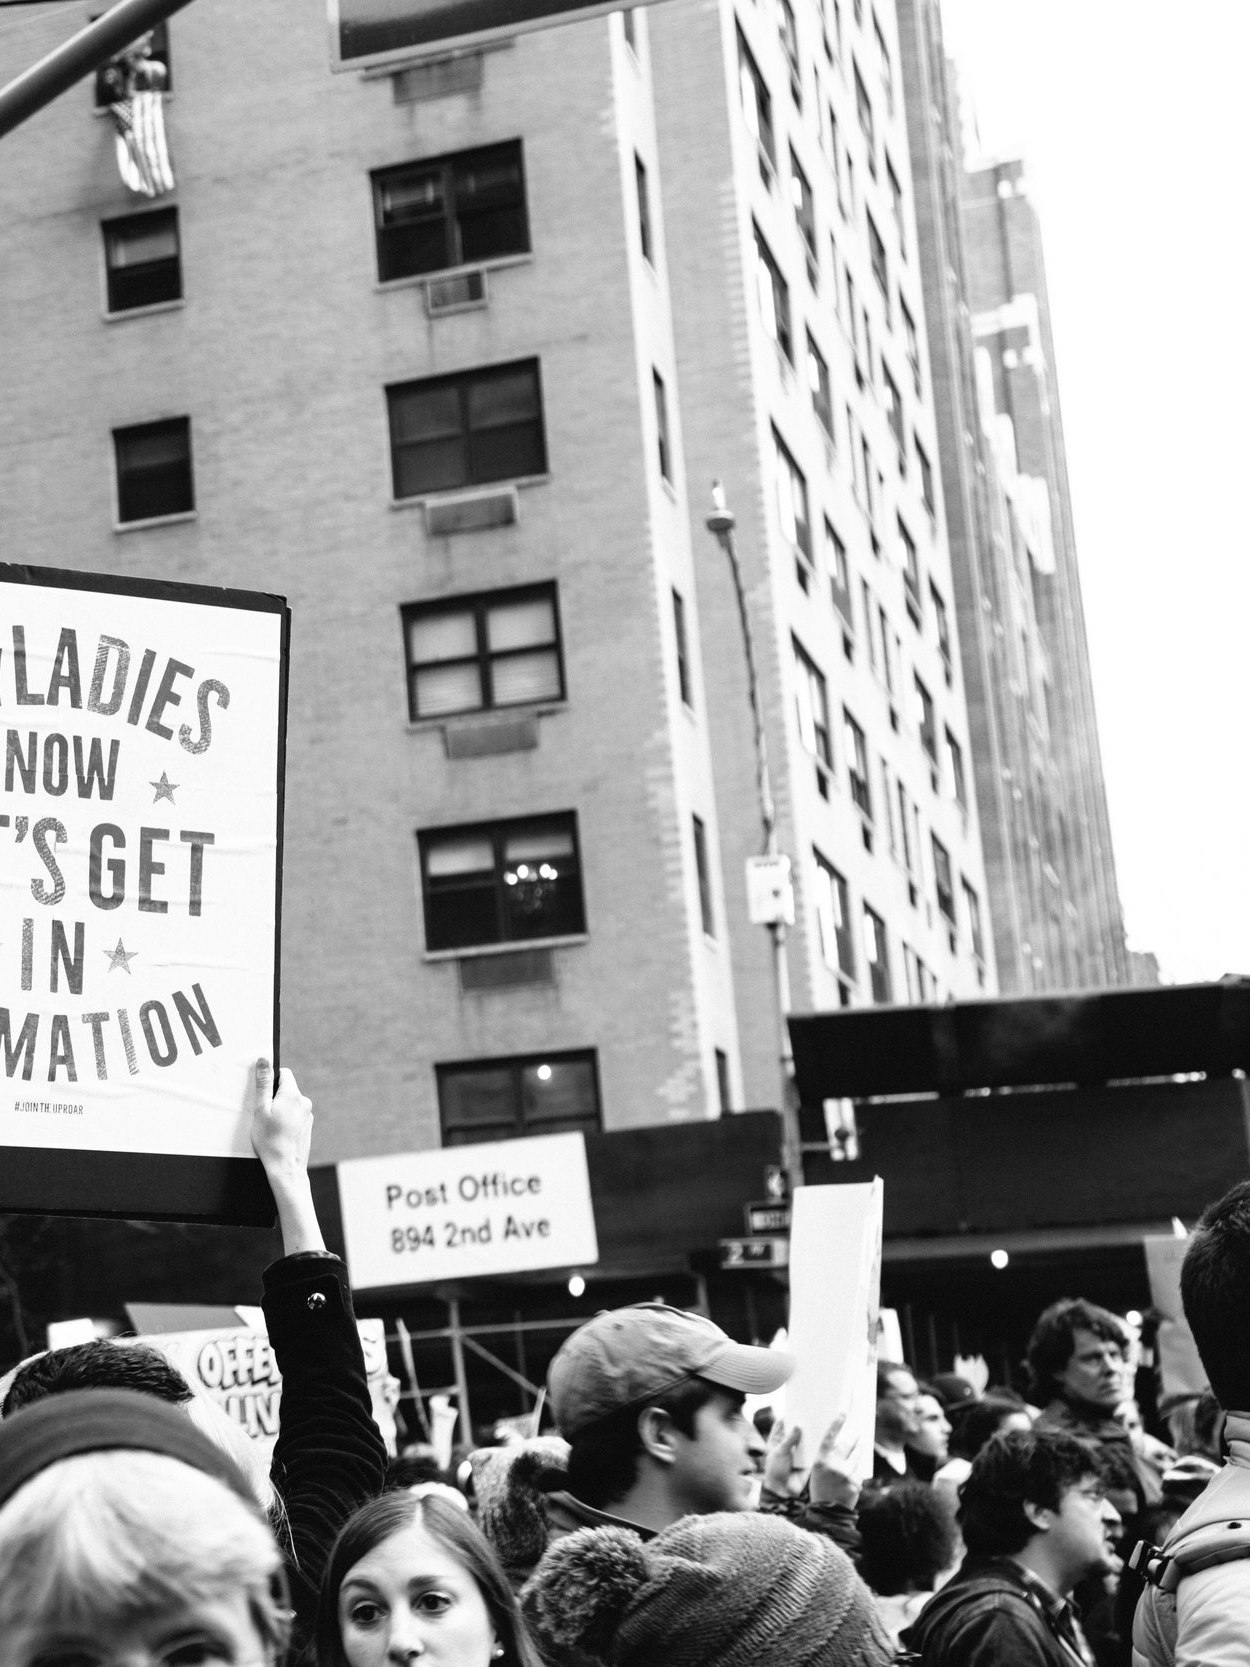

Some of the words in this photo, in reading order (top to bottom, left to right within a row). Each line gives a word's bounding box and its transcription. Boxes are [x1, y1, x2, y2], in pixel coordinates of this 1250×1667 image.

[12, 624, 232, 756] LADIES
[4, 728, 121, 801] NOW
[88, 822, 216, 917] GET
[20, 918, 85, 995] IN
[385, 1182, 448, 1209] Post
[458, 1171, 543, 1202] Office
[391, 1223, 436, 1254] 894
[444, 1217, 493, 1247] 2nd
[504, 1214, 552, 1240] Ave
